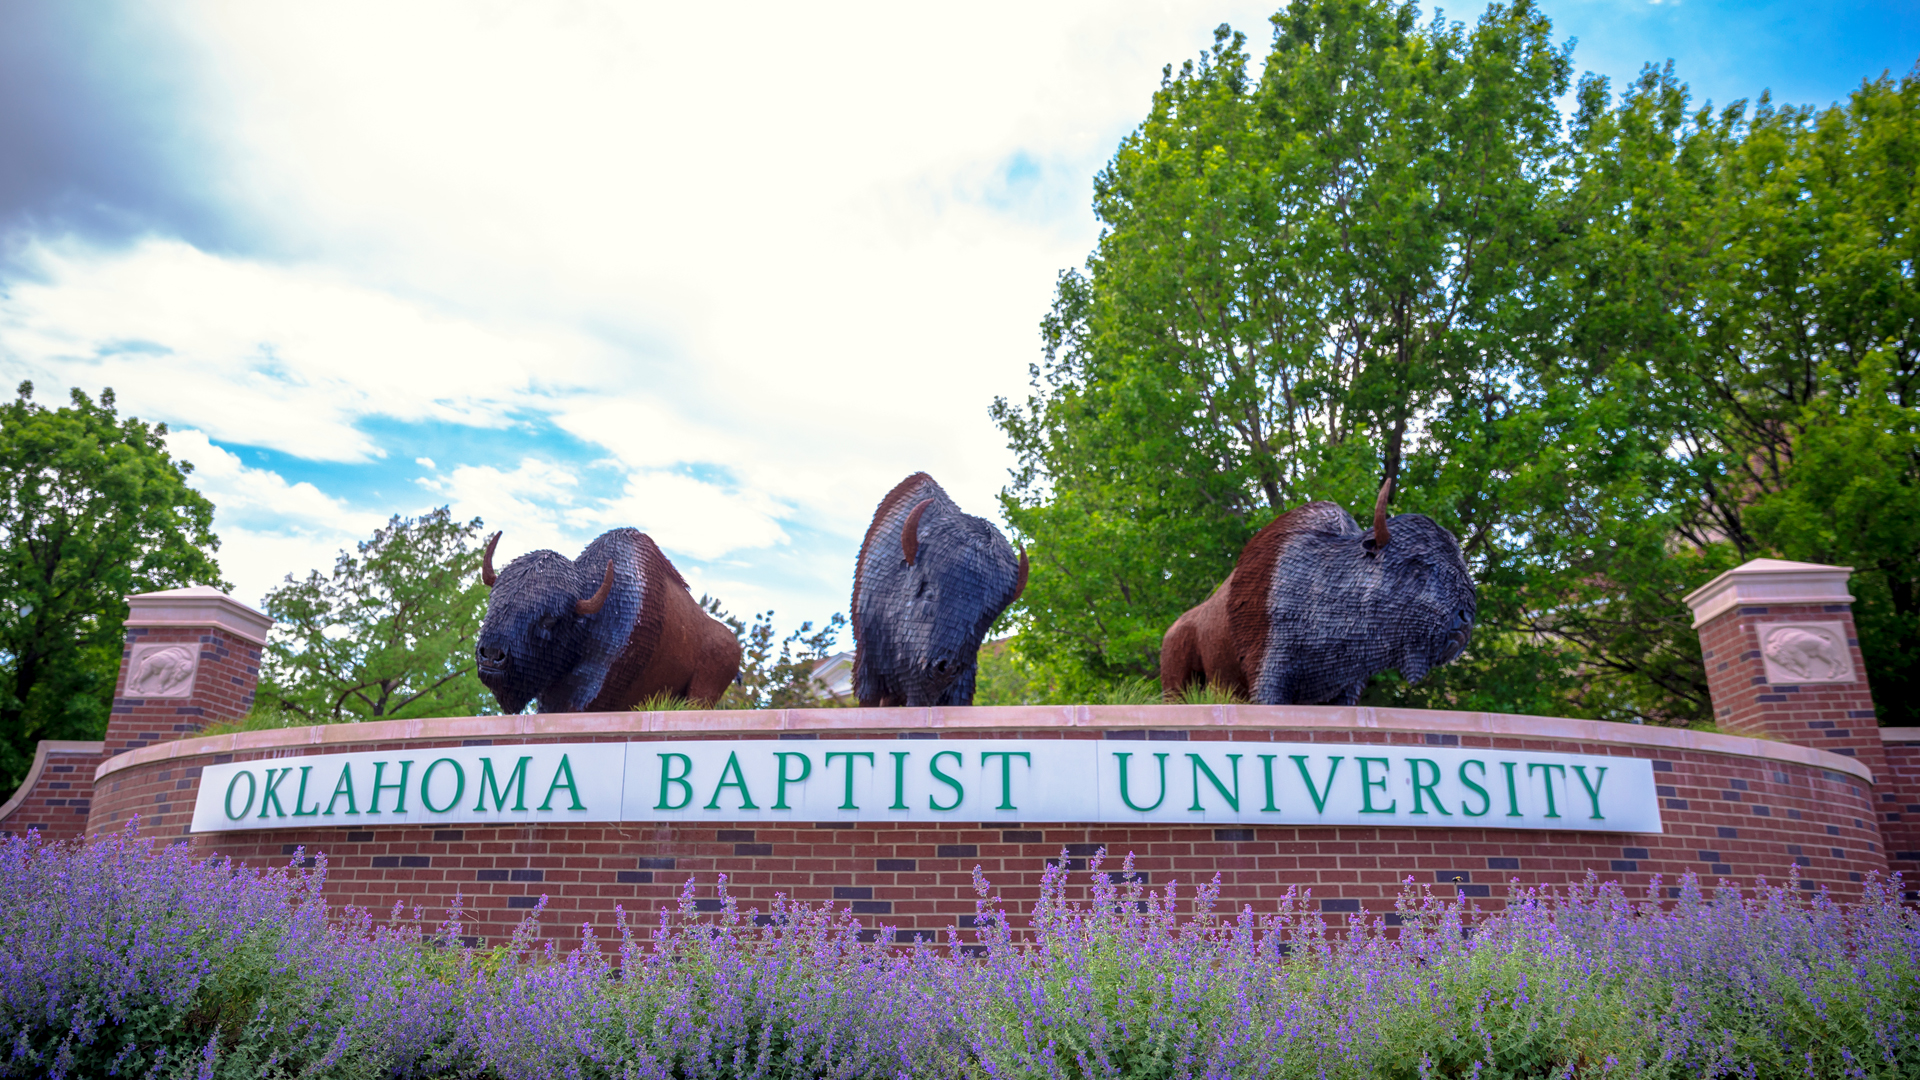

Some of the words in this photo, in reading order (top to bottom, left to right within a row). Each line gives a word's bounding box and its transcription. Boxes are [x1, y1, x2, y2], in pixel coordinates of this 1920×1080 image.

[224, 753, 587, 821] OKLAHOMA
[652, 750, 1032, 812] BAPTIST
[1111, 751, 1609, 820] UNIVERSITY
